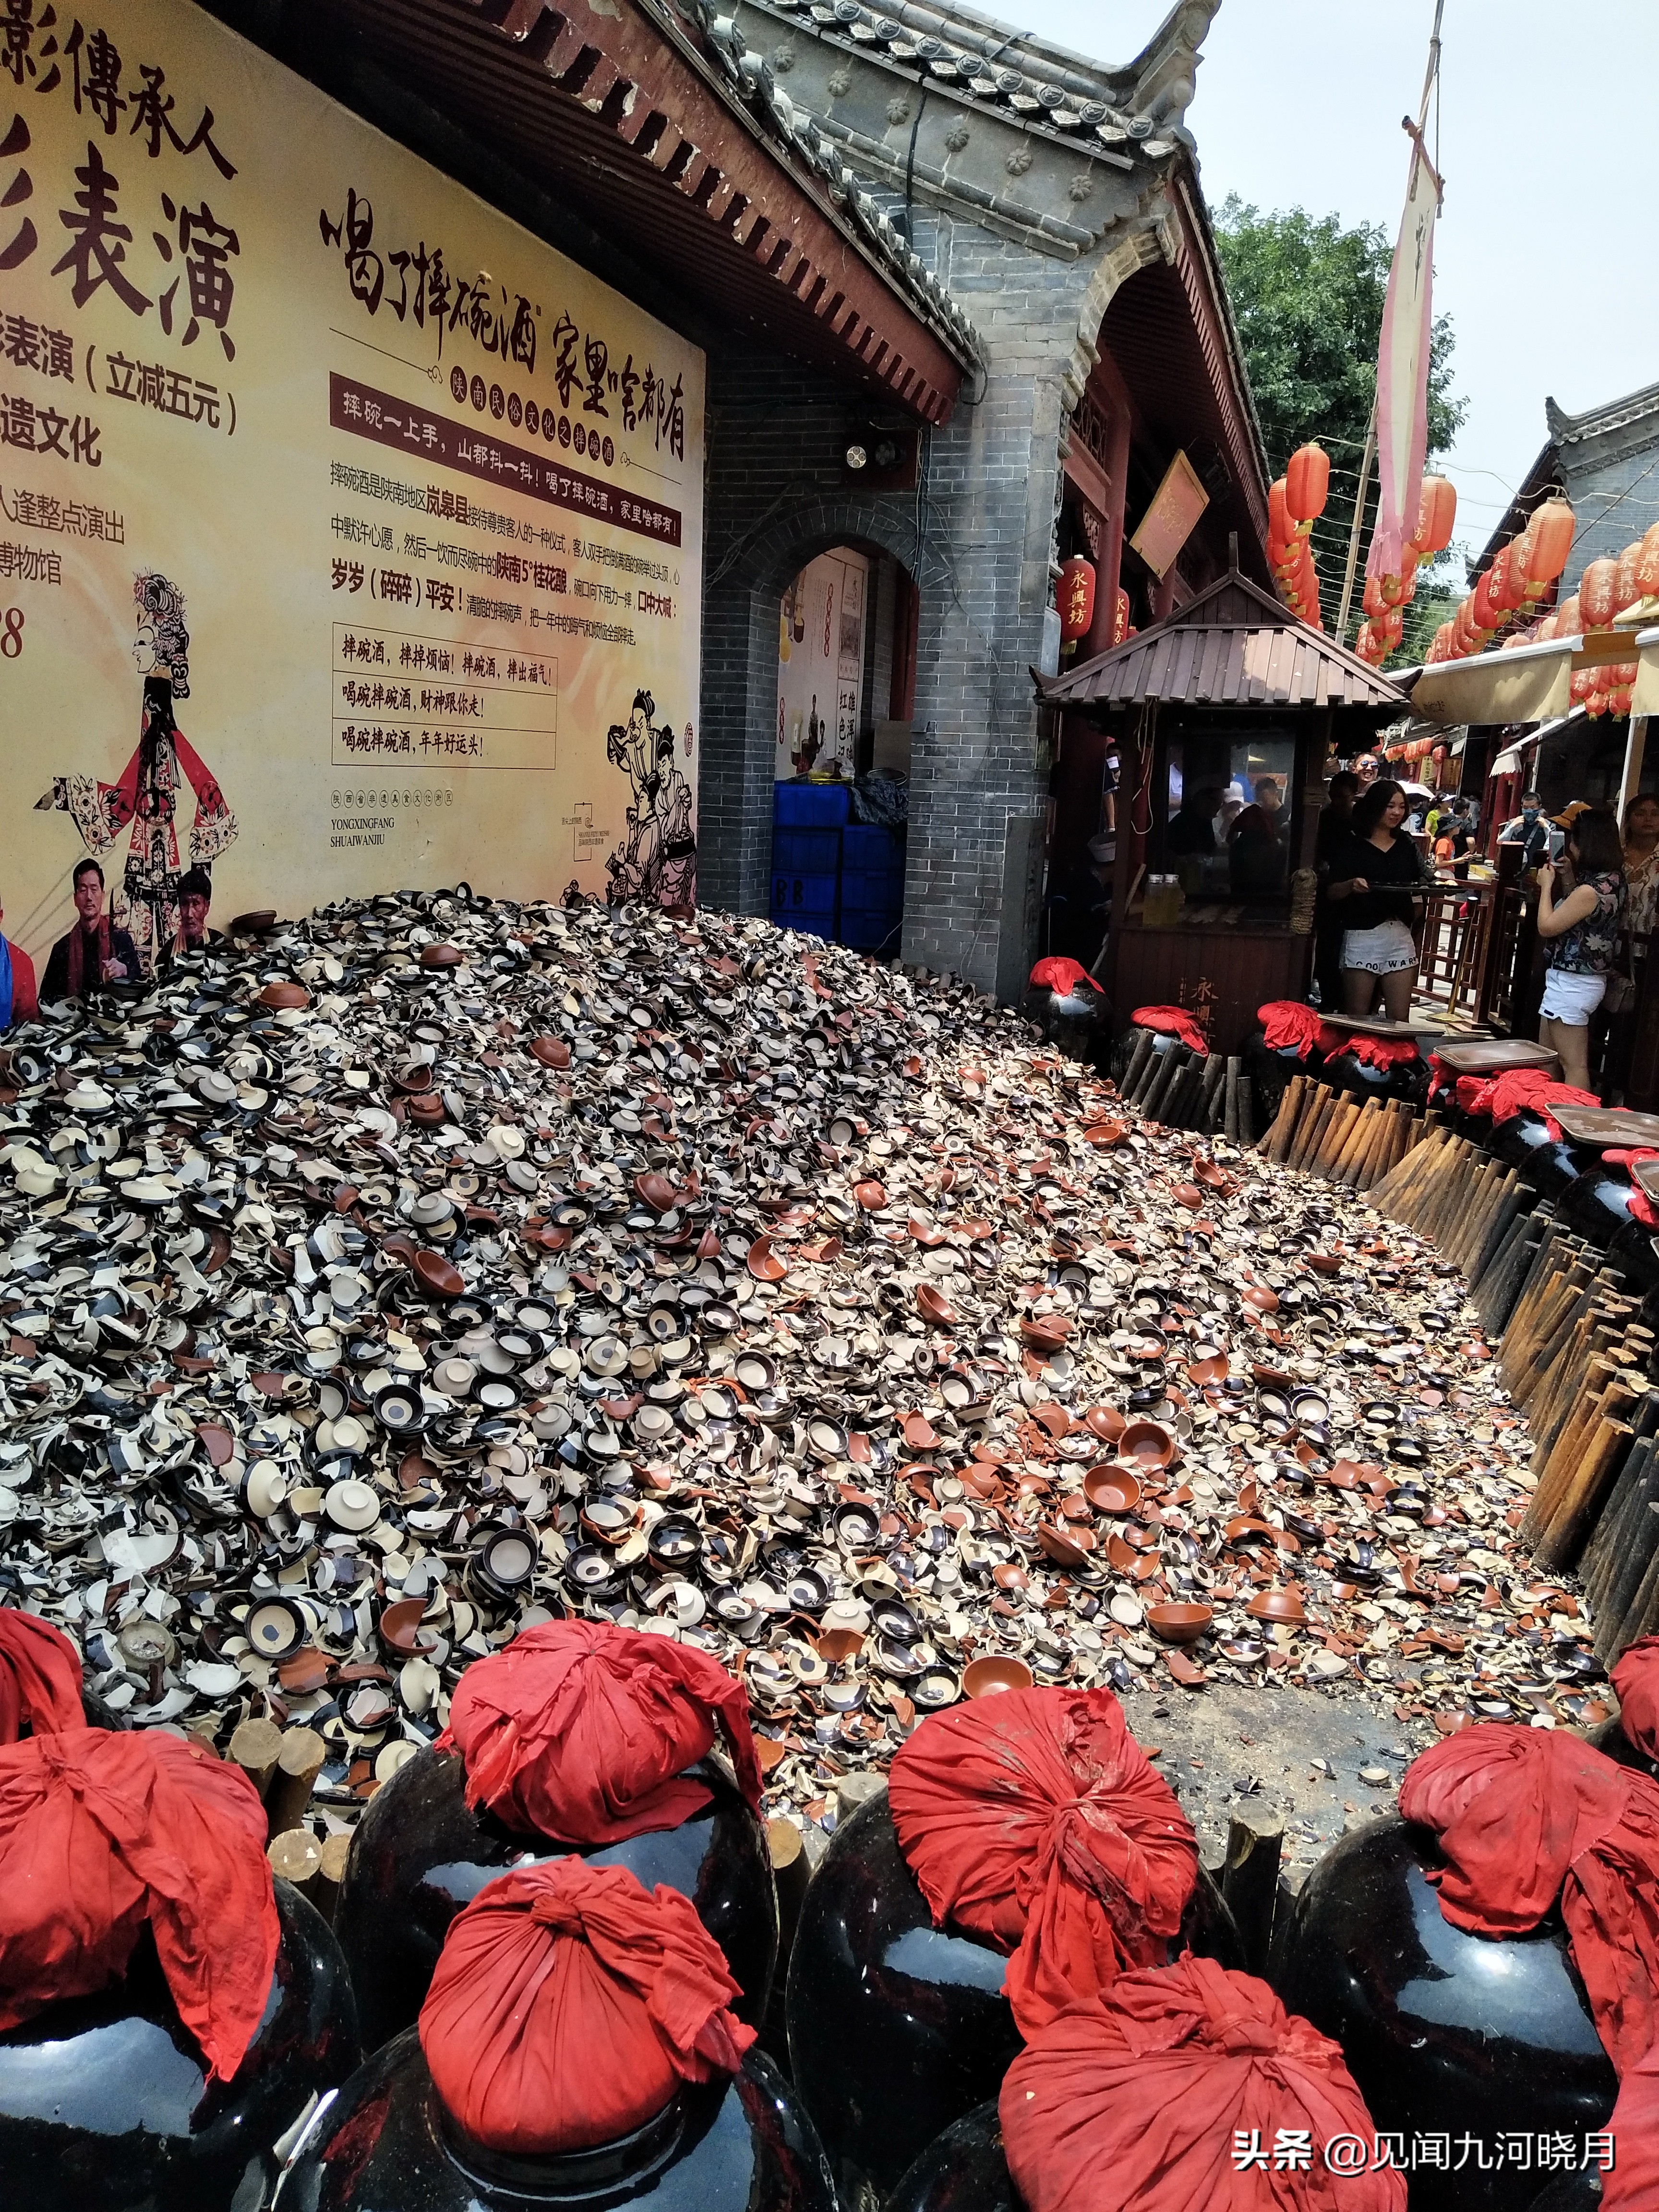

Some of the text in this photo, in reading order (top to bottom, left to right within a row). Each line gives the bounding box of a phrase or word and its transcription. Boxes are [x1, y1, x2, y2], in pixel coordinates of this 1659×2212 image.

[319, 187, 685, 462] 喝了摔碗酒 家里啥都有
[0, 311, 236, 436] 表演（立减五元）
[452, 373, 613, 462] 陕南民俗文化之摔碗酒
[1067, 570, 1088, 625] 永興坊
[330, 834, 385, 848] SHUAIWANJIU
[331, 817, 395, 830] YONGXINGFANG
